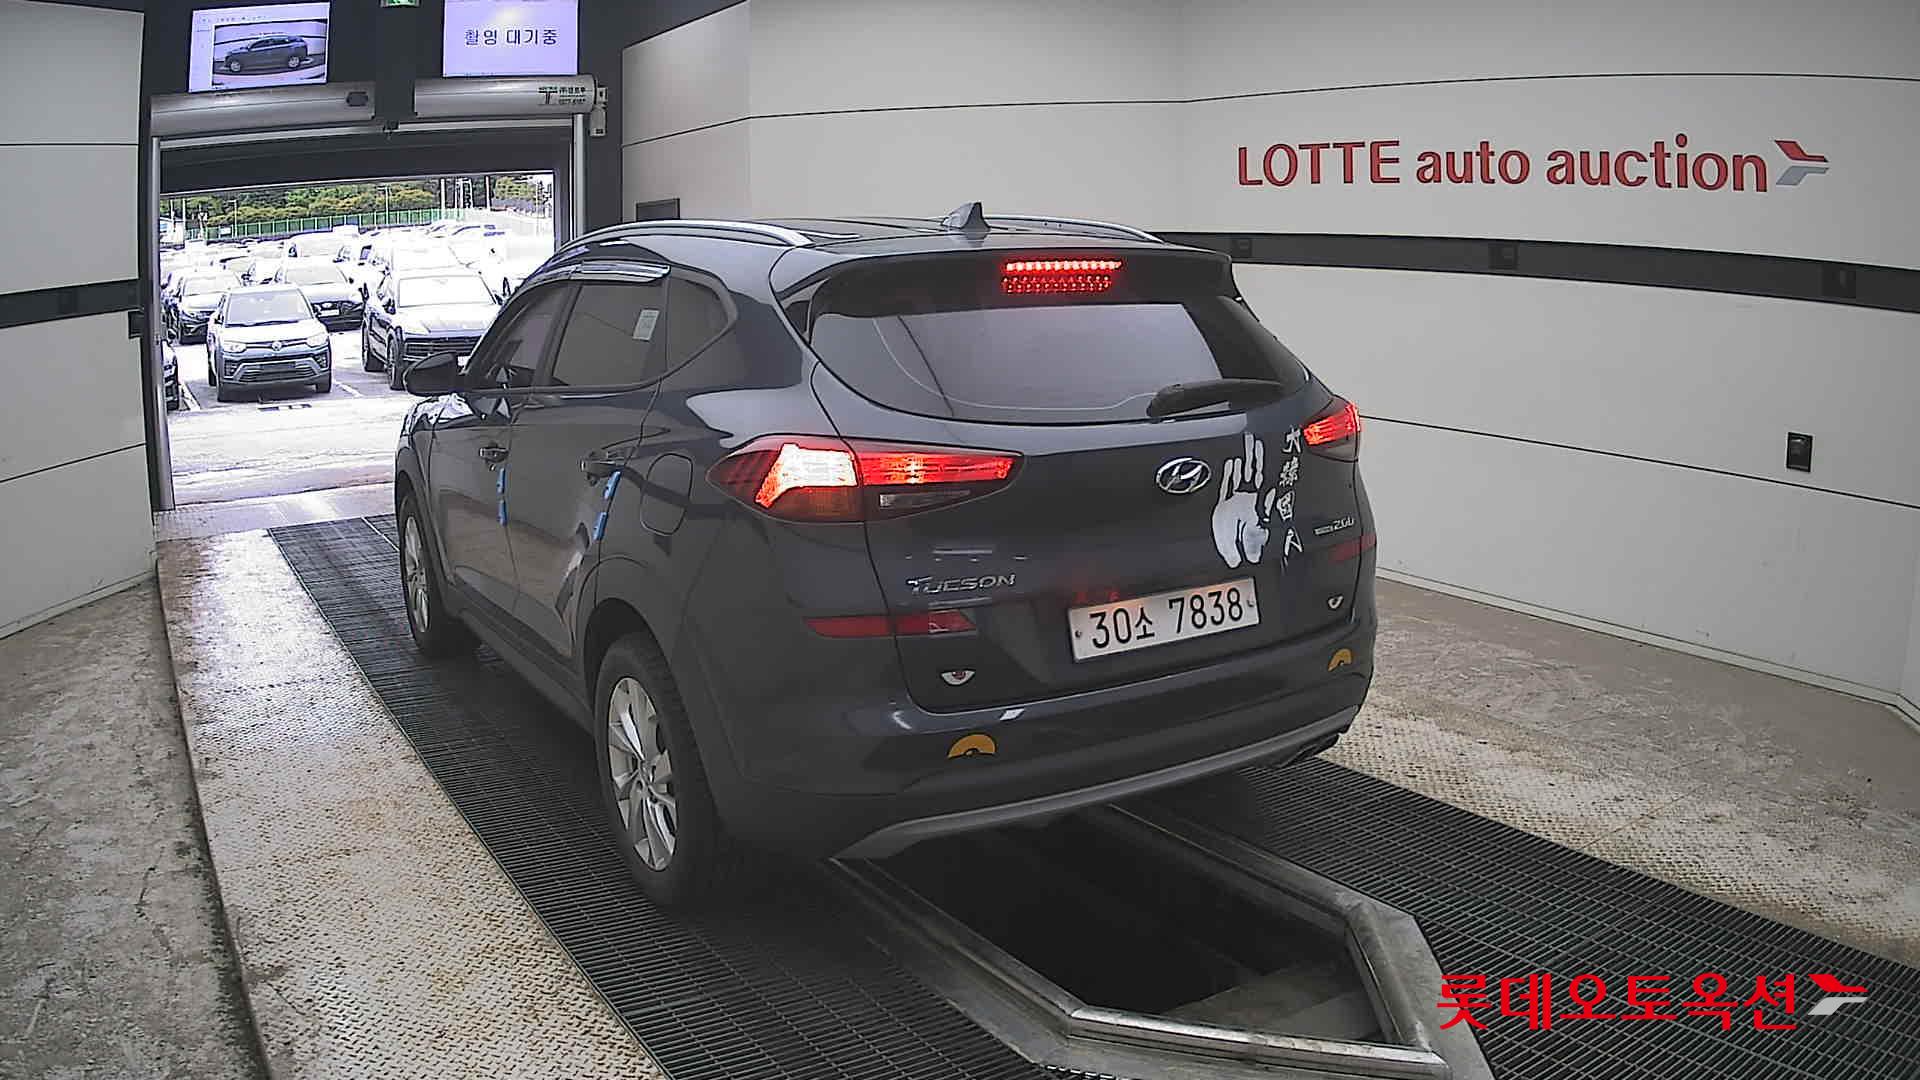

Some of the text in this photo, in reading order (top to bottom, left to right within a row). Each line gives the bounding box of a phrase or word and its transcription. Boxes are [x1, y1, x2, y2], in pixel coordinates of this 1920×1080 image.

[464, 28, 498, 46] 촬영
[1238, 133, 1768, 193] LOTTE auto auction
[1088, 587, 1244, 649] 30소 7838
